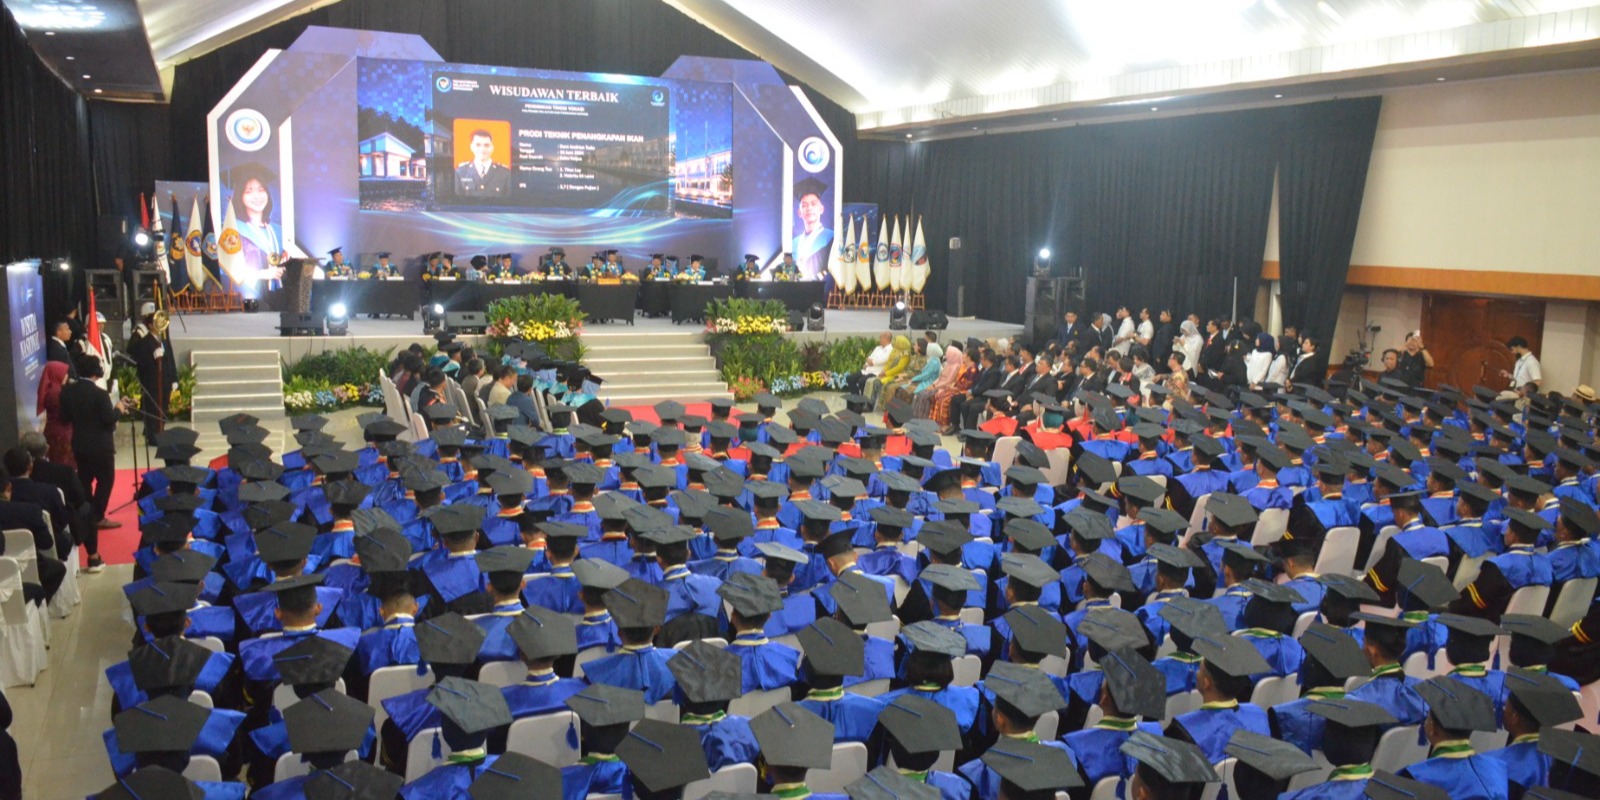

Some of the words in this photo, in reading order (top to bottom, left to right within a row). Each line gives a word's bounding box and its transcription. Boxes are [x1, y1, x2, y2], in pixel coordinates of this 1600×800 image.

[489, 84, 564, 99] WISUDAWAN
[566, 89, 619, 103] TERBAIK
[519, 129, 542, 138] PRODI
[544, 130, 571, 139] TEKNIK
[572, 132, 625, 142] PENANGKAPAN
[626, 135, 644, 143] IKAN
